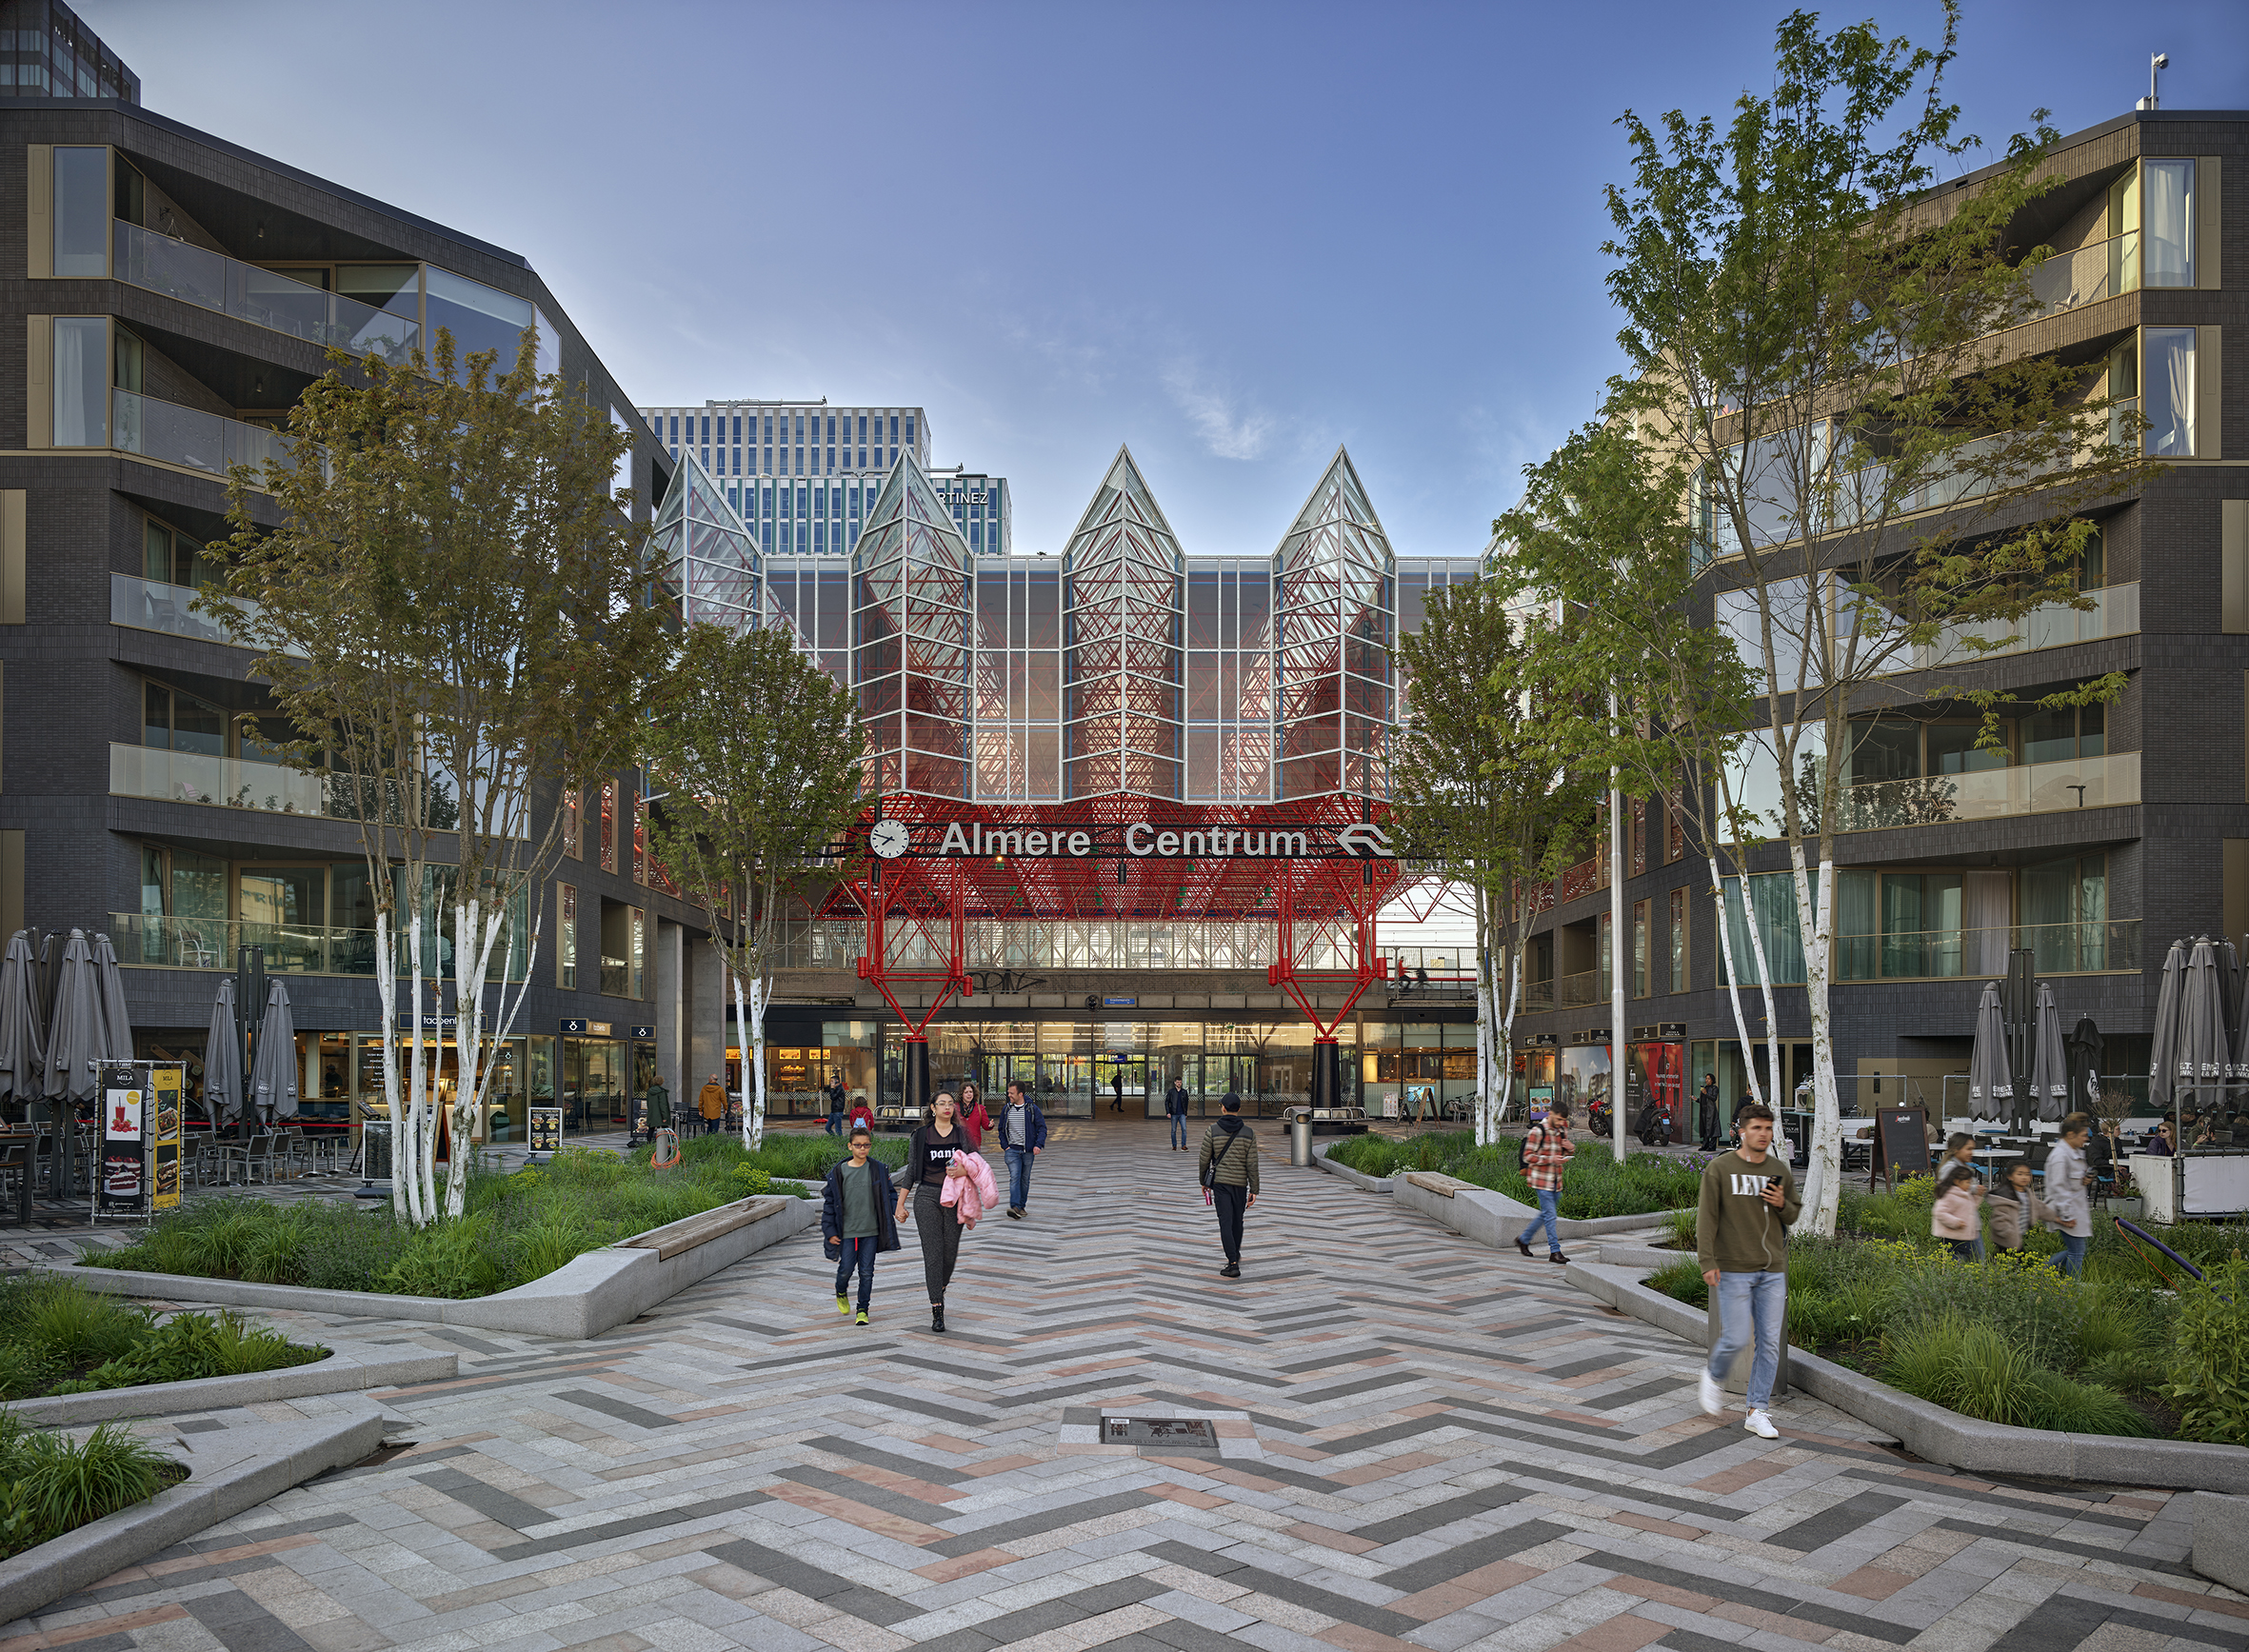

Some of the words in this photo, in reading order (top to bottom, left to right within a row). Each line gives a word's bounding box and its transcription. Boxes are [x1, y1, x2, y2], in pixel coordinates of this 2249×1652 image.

[937, 492, 988, 504] RTINEZ
[938, 822, 1091, 856] Almere
[1125, 822, 1307, 856] Centrum
[423, 1016, 457, 1025] taoent
